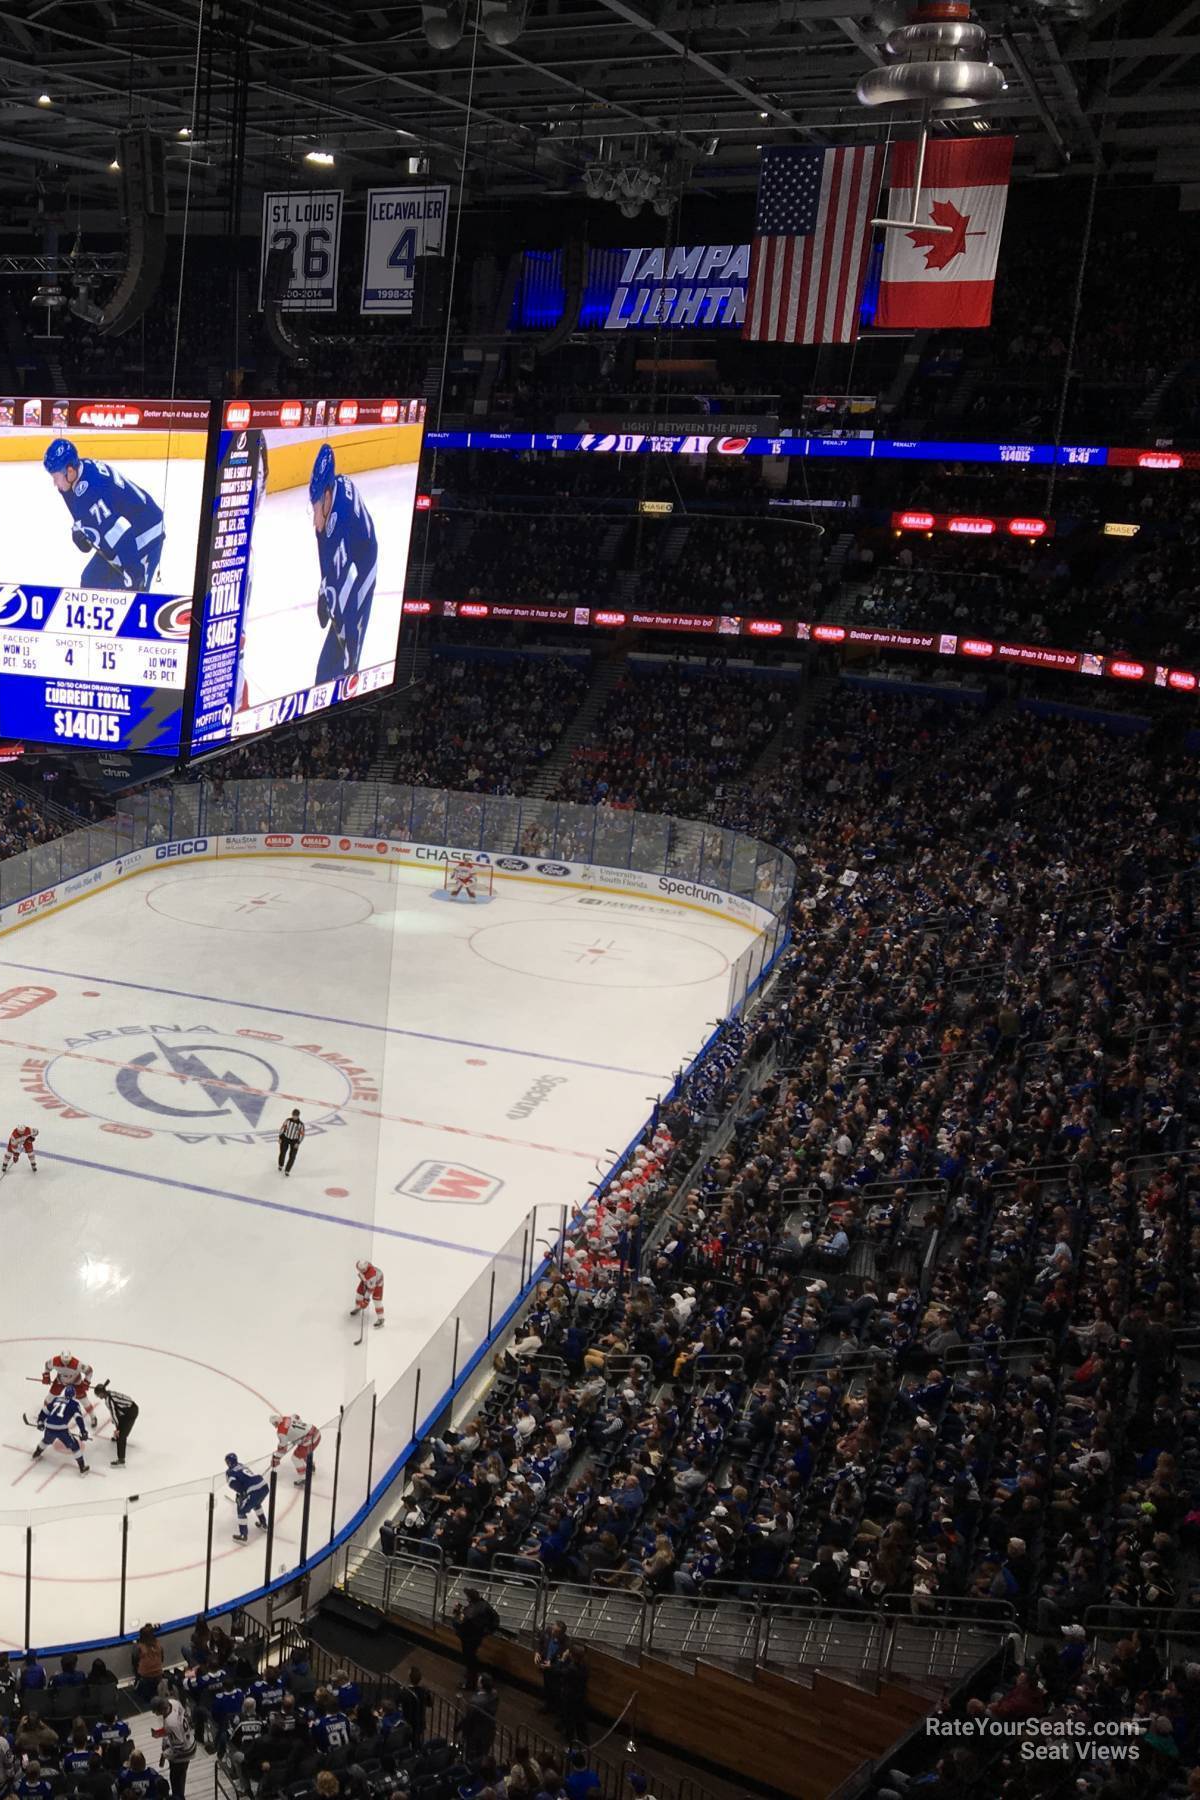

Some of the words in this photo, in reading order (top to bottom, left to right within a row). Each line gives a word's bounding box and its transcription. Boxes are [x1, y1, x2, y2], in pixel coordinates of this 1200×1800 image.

[272, 205, 291, 222] ST.
[295, 204, 334, 222] LOUIS
[372, 201, 443, 221] LECAVALIER
[387, 226, 417, 280] 4
[619, 245, 750, 283] TAMPA
[376, 289, 414, 299] 1998-20
[603, 287, 748, 329] LIGHTN
[621, 422, 651, 431] LIGHT
[657, 422, 706, 432] BETWEEN
[707, 423, 728, 433] THE
[729, 423, 759, 433] PIPES
[551, 440, 559, 449] 4
[624, 436, 633, 450] 0
[651, 442, 674, 453] 14:52
[694, 438, 701, 452] 1
[771, 444, 782, 455] 15
[1000, 451, 1031, 462] $14015
[1068, 452, 1091, 463] 8:43
[89, 499, 112, 526] 71
[211, 568, 244, 586] CURRENT
[64, 592, 89, 603] 2ND
[91, 593, 127, 606] Period
[209, 582, 241, 617] TOTAL
[31, 596, 44, 620] 0
[138, 603, 148, 629] 1
[66, 604, 114, 632] 14:52
[2, 634, 40, 644] FACEOFF
[206, 618, 237, 650] $14015
[849, 630, 873, 640] Better
[873, 633, 890, 642] than
[890, 634, 897, 643] it
[897, 635, 912, 644] has
[912, 637, 921, 645] to
[921, 637, 933, 646] be
[3, 644, 20, 655] WON
[22, 646, 30, 656] 13
[55, 639, 84, 648] SHOTS
[95, 642, 124, 651] SHOTS
[137, 645, 178, 656] FACEOFF
[64, 648, 73, 666] 4
[102, 651, 116, 670] 15
[148, 657, 158, 667] 10
[159, 658, 178, 669] WON
[143, 670, 158, 681] 435
[56, 681, 75, 689] 50/50
[91, 685, 121, 693] DRAWING
[45, 687, 95, 708] CURRENT
[96, 691, 131, 710] TOTAL
[54, 710, 120, 743] $14015
[195, 709, 222, 728] MOFFITT
[266, 835, 293, 846] AMALIE
[302, 836, 331, 847] AMALIE
[155, 839, 209, 860] GEICO
[415, 847, 473, 862] CHASE
[599, 868, 637, 880] University
[599, 876, 621, 885] South
[622, 878, 648, 889] Florida
[37, 888, 56, 905] DEX
[658, 878, 721, 905] Spectrum
[17, 898, 36, 914] DEX
[63, 1024, 218, 1048] ARENA
[295, 1043, 379, 1103] AMALIE
[19, 1058, 92, 1119] AMALIE
[508, 1073, 569, 1120] Spectrum
[51, 1401, 66, 1417] 71
[328, 1728, 350, 1746] 91
